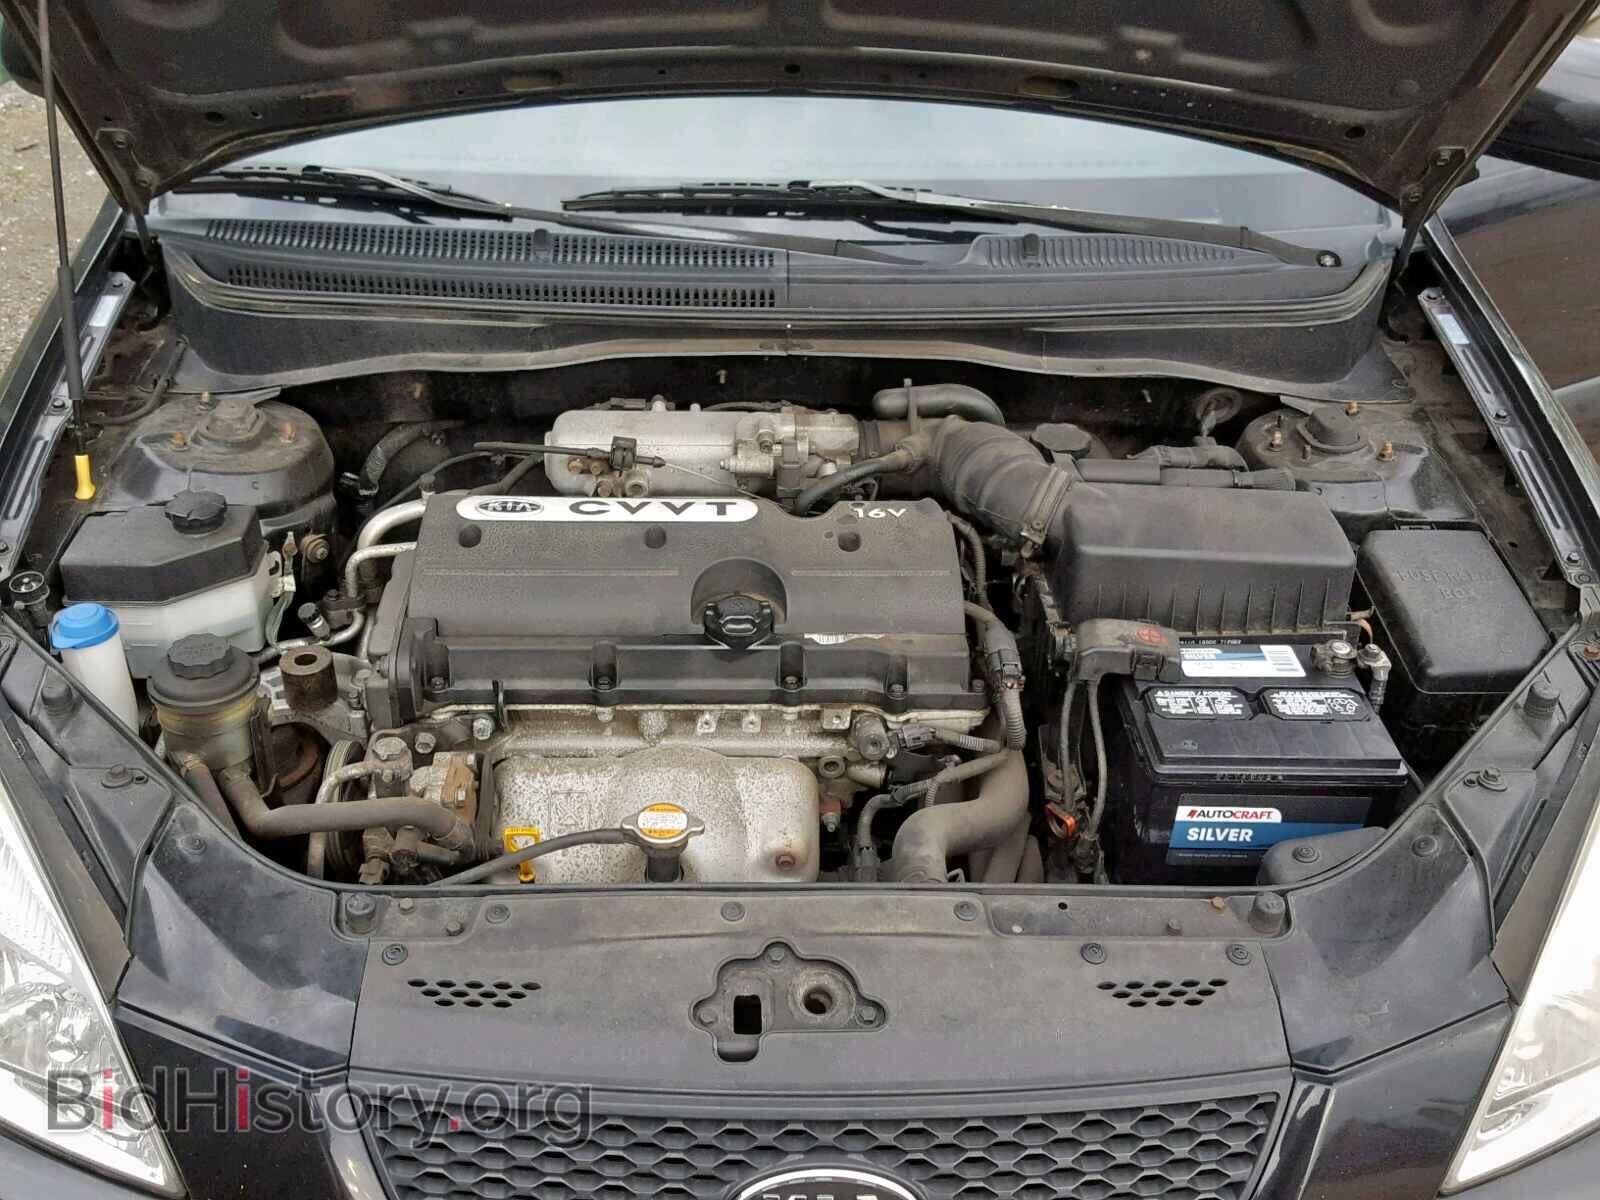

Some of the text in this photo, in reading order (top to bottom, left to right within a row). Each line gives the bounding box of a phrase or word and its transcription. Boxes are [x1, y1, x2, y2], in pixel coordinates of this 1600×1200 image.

[487, 502, 532, 511] KIA
[568, 501, 737, 517] CVVT
[853, 508, 907, 518] 16V
[1195, 809, 1273, 821] AUTOCRAFT
[1187, 828, 1253, 842] SILVER
